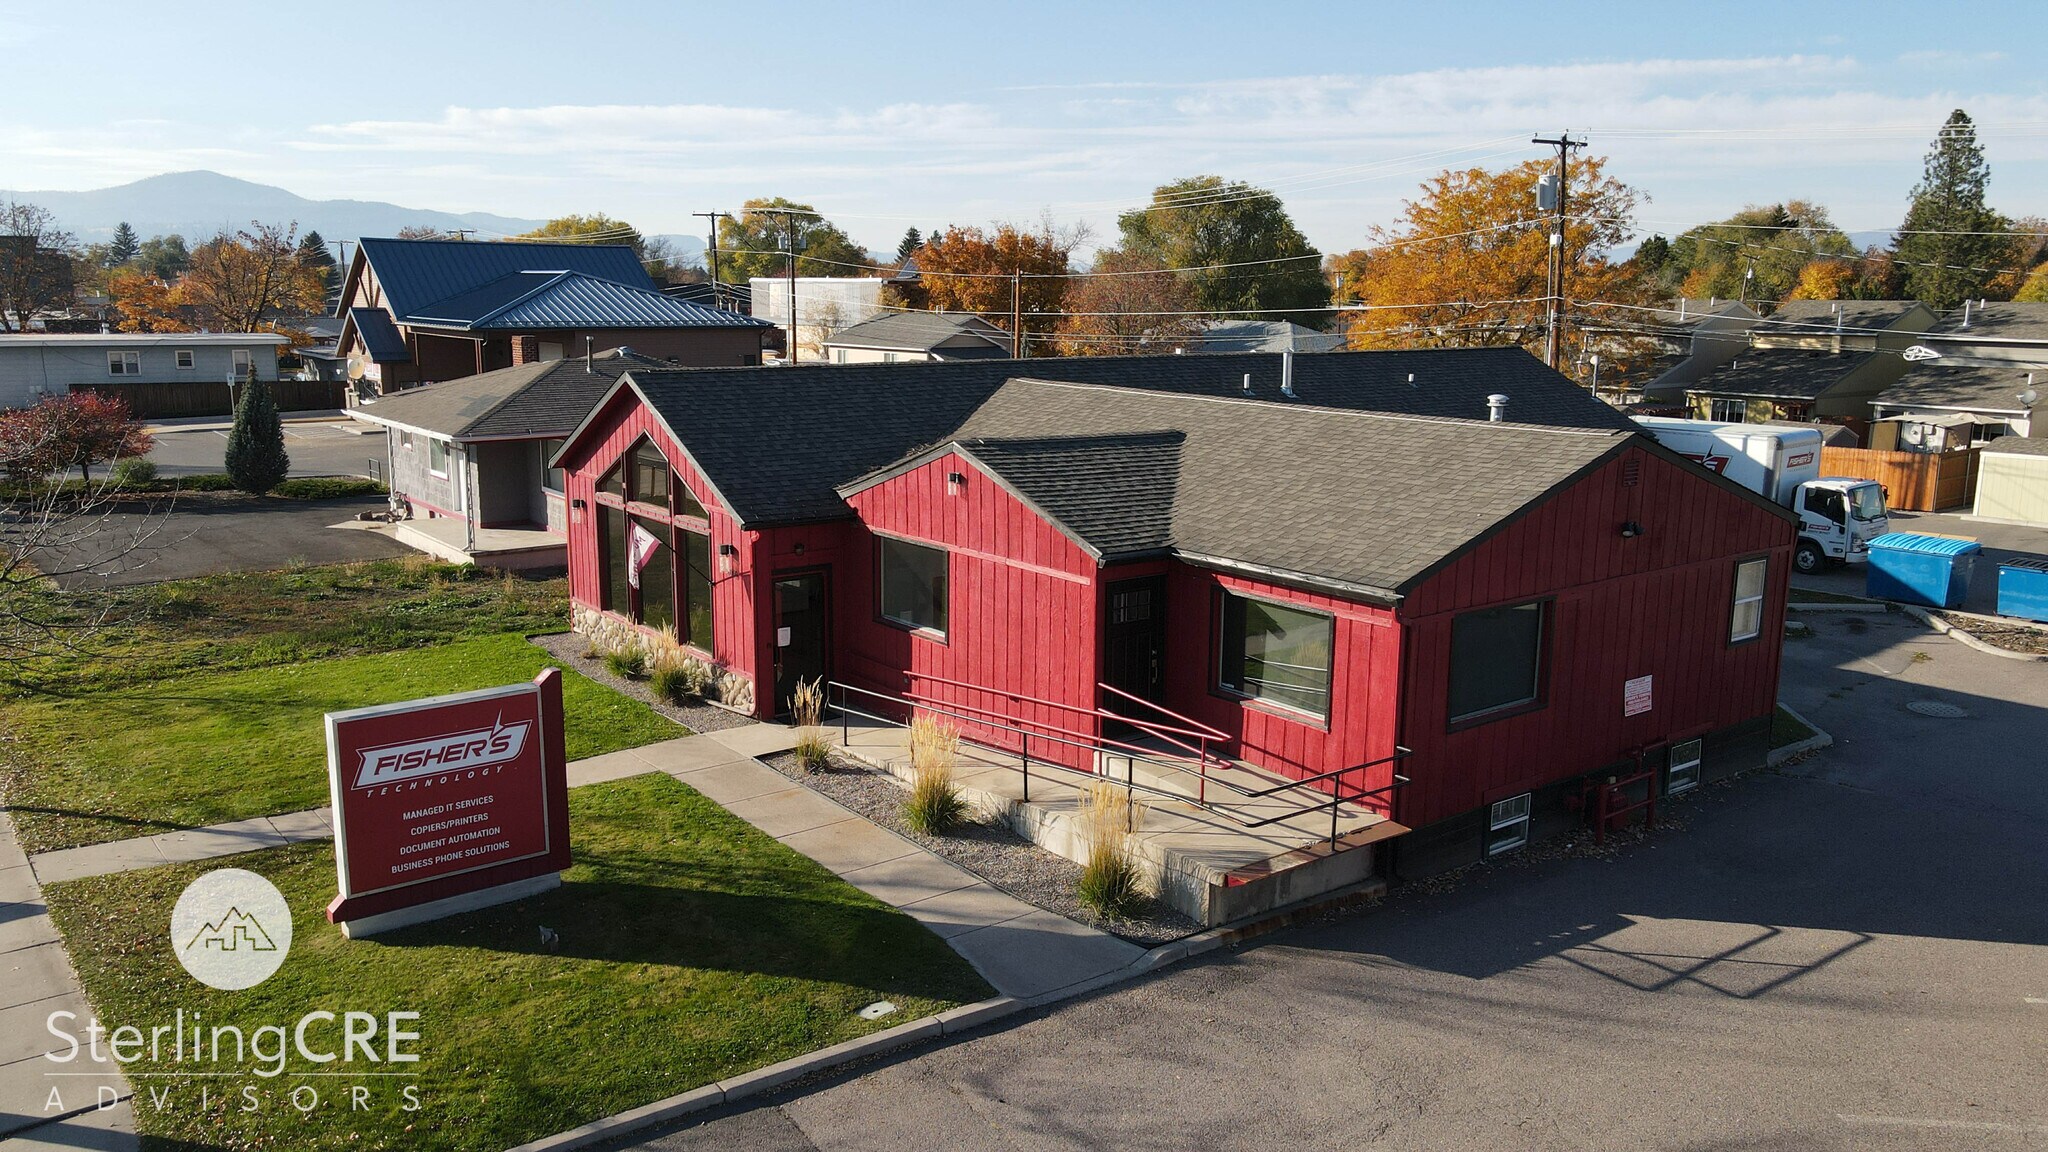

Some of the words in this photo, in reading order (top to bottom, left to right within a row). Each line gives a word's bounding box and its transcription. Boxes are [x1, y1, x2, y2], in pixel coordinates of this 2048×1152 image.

[374, 709, 511, 776] FISHER'S
[367, 765, 503, 798] TECHNOLOGY
[403, 805, 444, 820] MANAGED
[446, 803, 454, 812] IT
[455, 795, 494, 810] SERVICES
[410, 812, 489, 836] COPIERS/PRINTERS
[400, 838, 446, 855] DOCUMENT
[448, 826, 501, 844] AUTOMATION
[391, 857, 433, 874] BUSINESS
[435, 850, 463, 864] PHONE
[464, 840, 510, 857] SOLUTIONS
